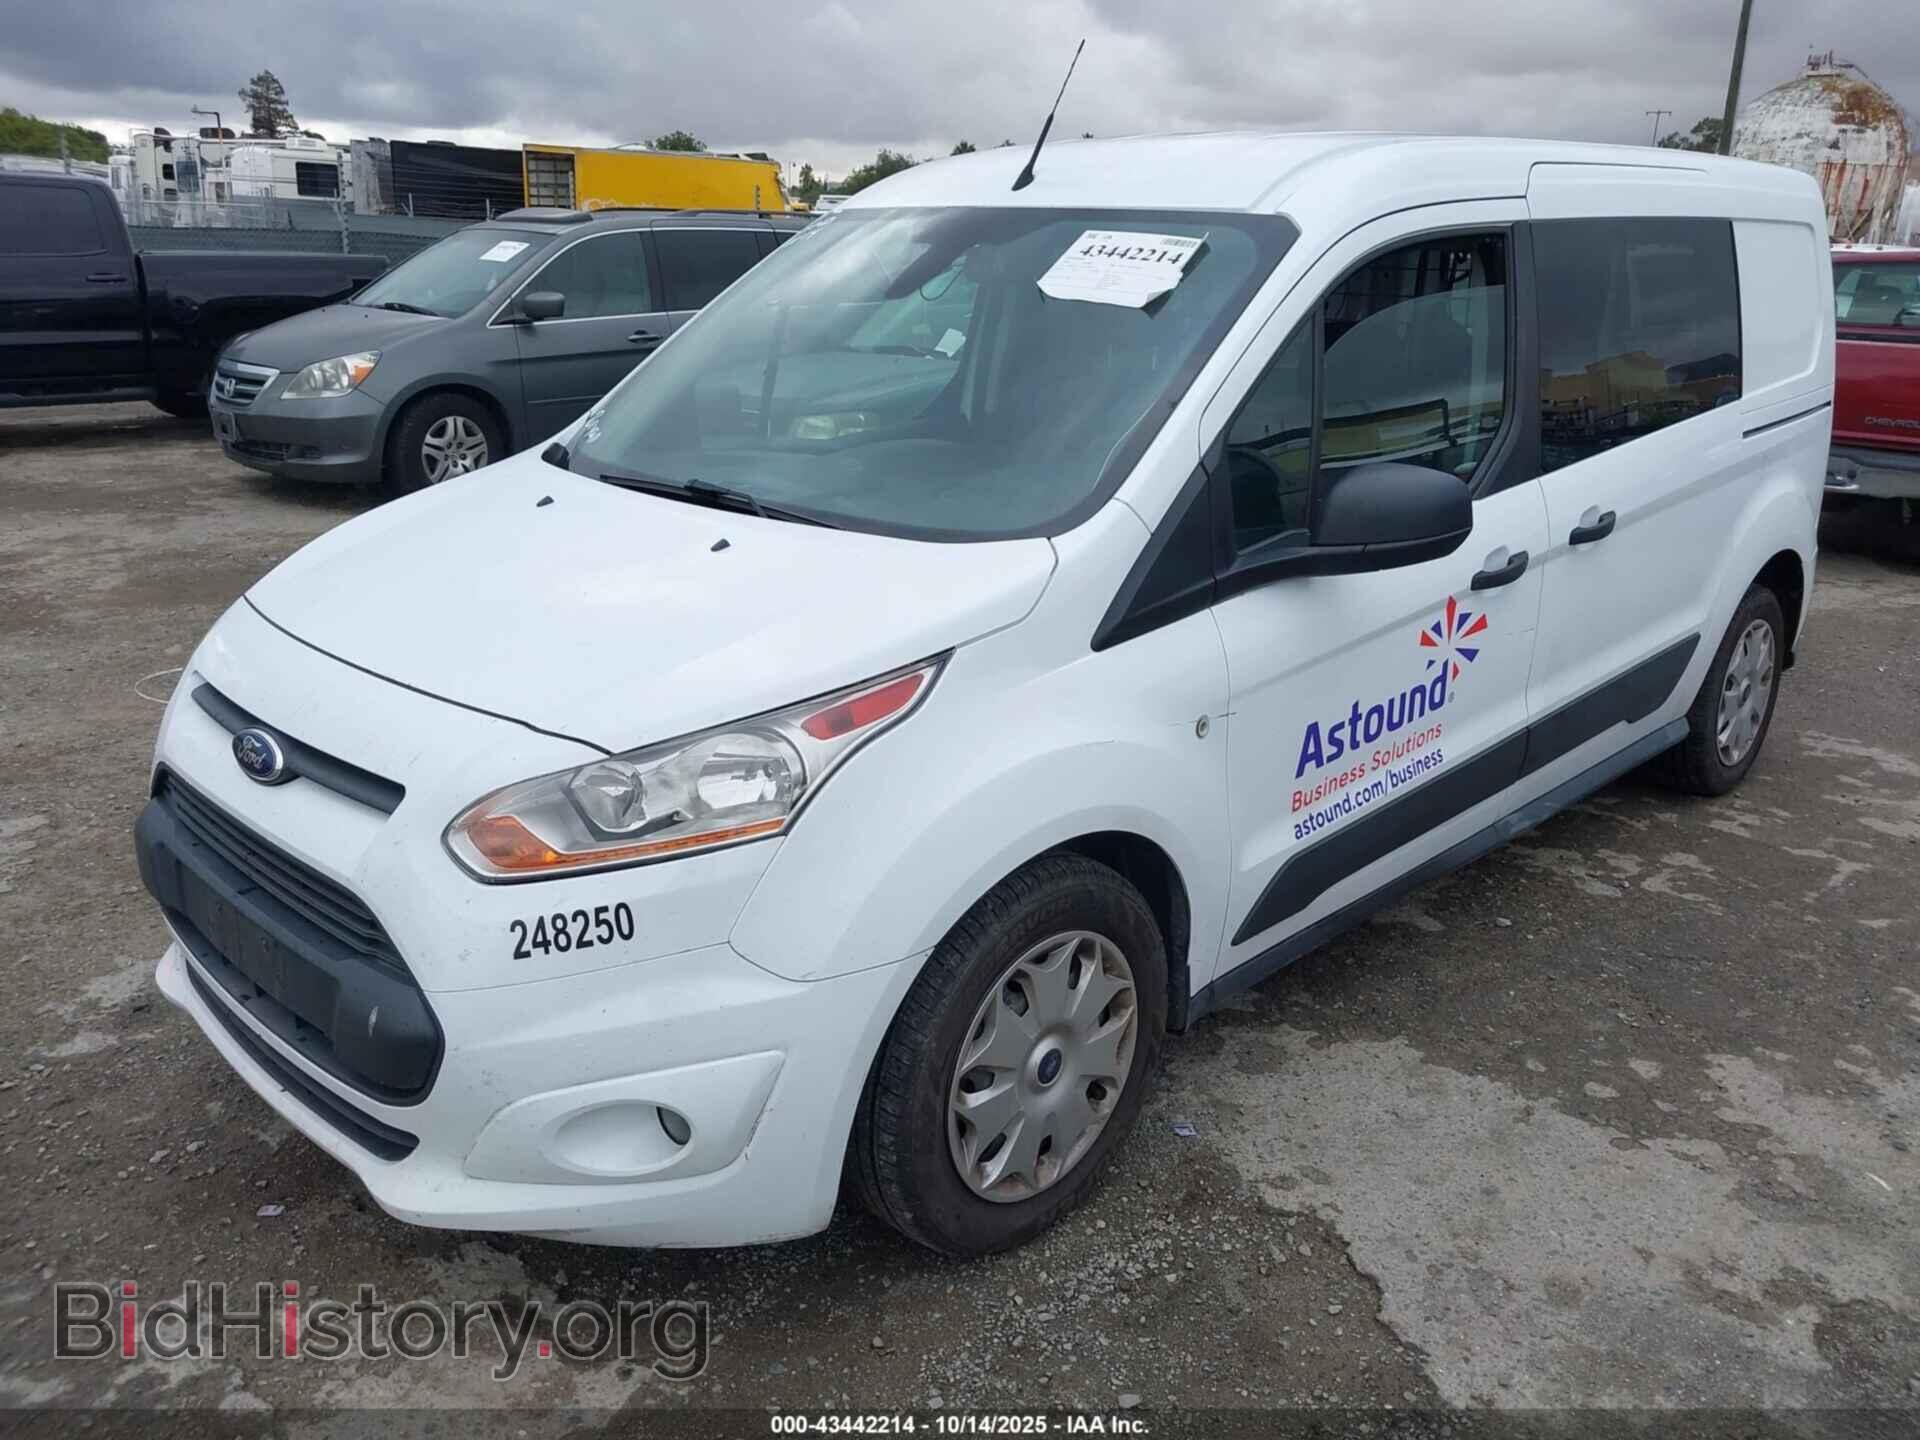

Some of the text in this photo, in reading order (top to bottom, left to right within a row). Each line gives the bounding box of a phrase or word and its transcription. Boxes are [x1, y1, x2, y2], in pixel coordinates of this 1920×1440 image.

[1079, 243, 1184, 265] 43442214
[1295, 657, 1450, 780] Astound
[1291, 722, 1443, 814] Business Solutions
[1294, 747, 1444, 840] astound.com/business
[510, 902, 635, 960] 248250
